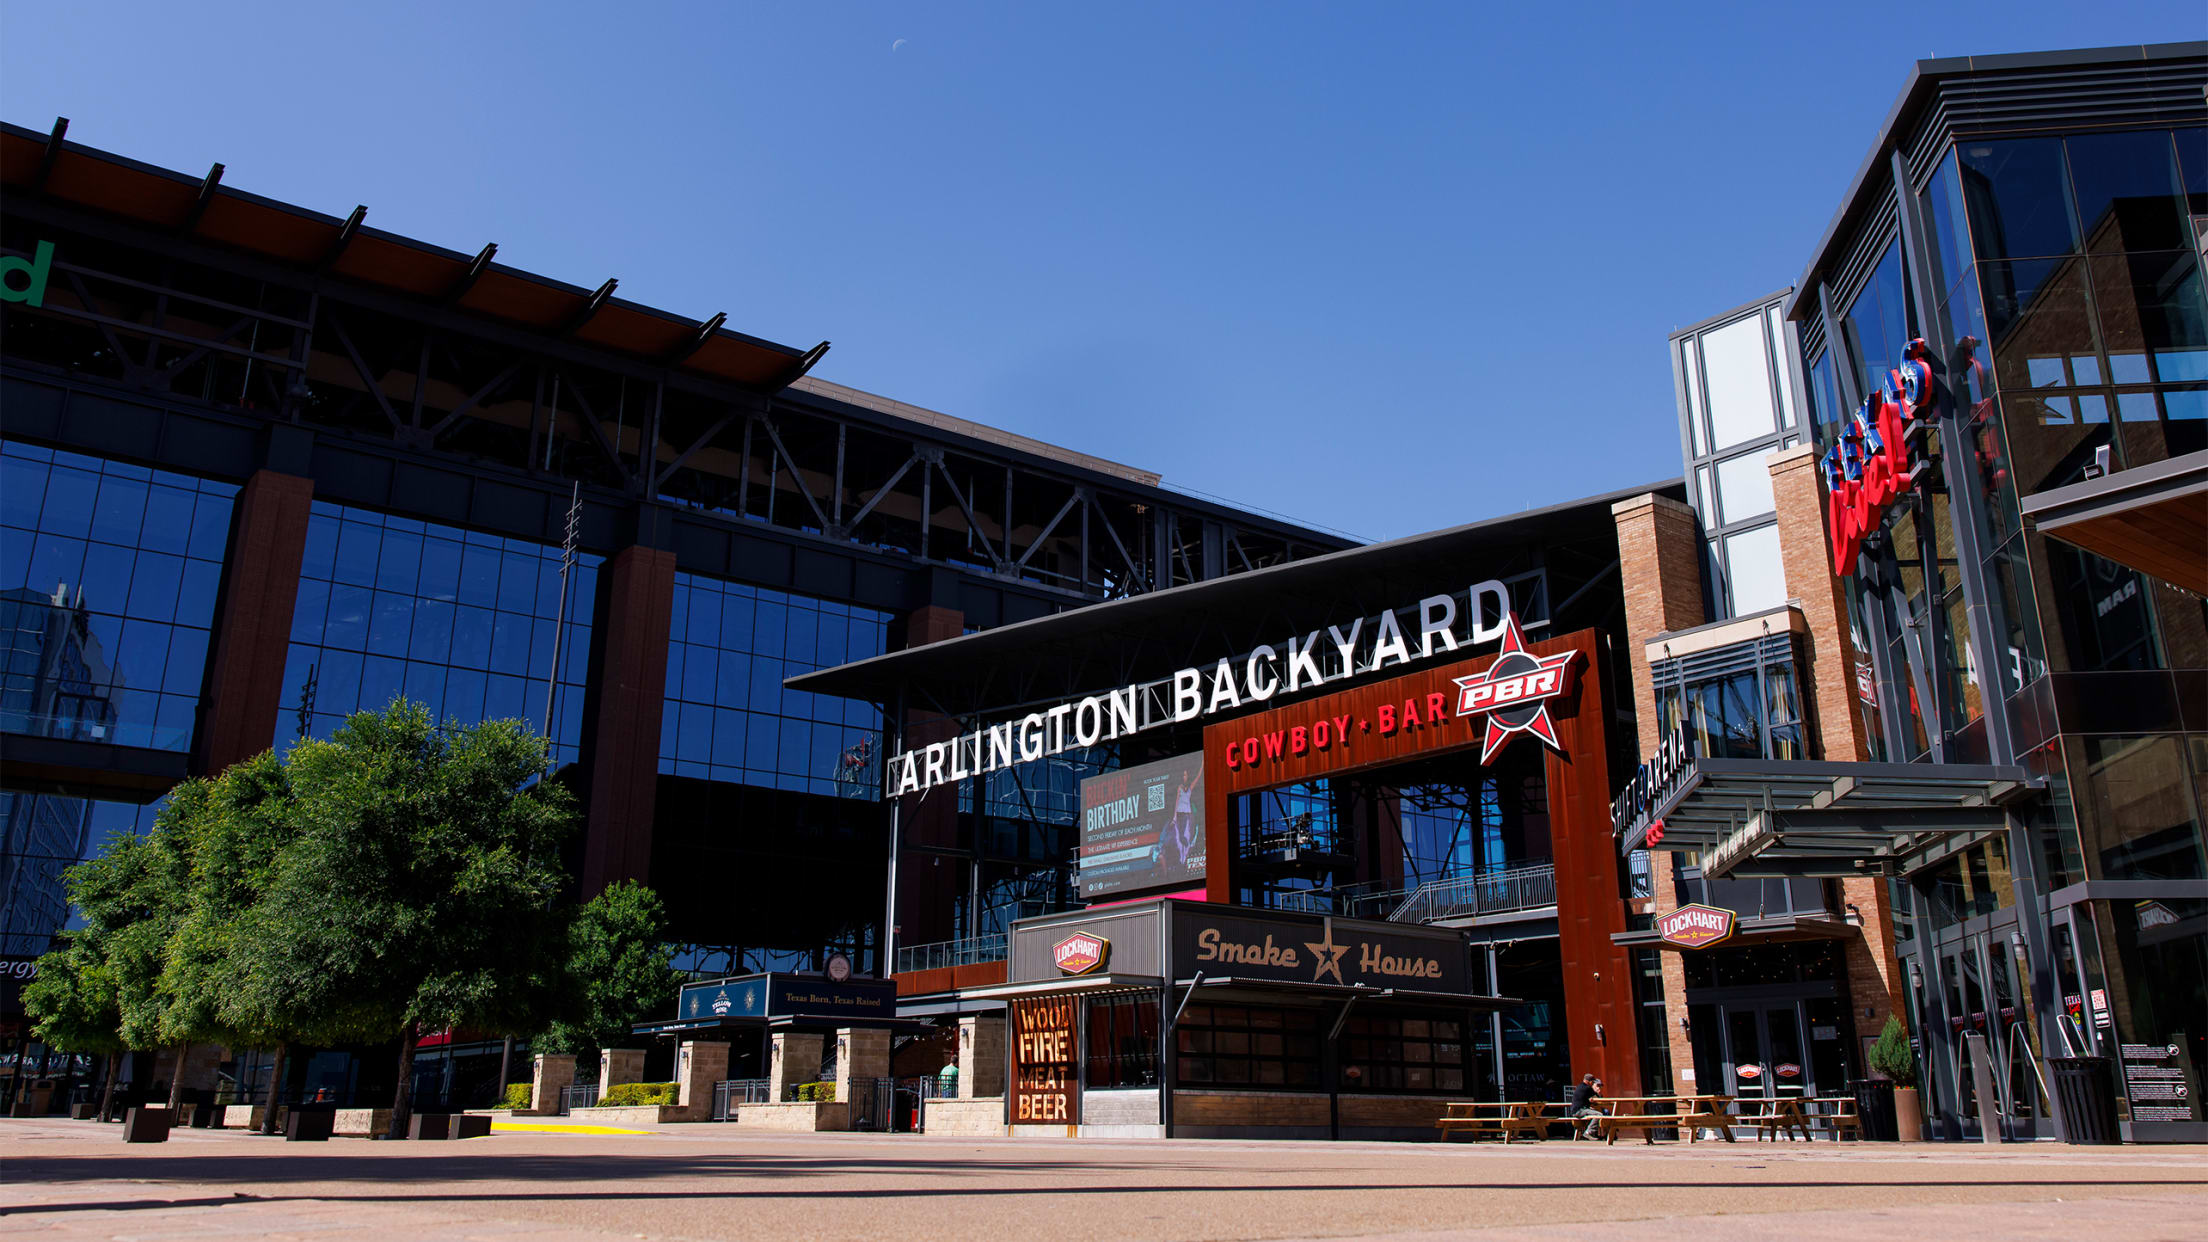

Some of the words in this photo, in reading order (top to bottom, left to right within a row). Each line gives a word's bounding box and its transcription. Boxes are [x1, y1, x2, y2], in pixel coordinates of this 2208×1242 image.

[899, 684, 1137, 795] ARLINGTON
[1174, 579, 1511, 722] BACKYARD
[1463, 670, 1556, 709] PBR
[1226, 714, 1350, 768] COWBOY
[1378, 692, 1448, 734] BAR
[1647, 720, 1686, 800] ARENA
[1087, 794, 1140, 831] BIRTHDAY
[1663, 911, 1724, 936] LOCKHART
[1057, 938, 1098, 963] LOCKHART
[1197, 928, 1300, 968] Smoke
[1360, 943, 1443, 978] House
[786, 993, 808, 1002] Texas
[810, 994, 832, 1004] Born,
[834, 995, 854, 1004] Texas
[856, 996, 881, 1006] Raised
[1021, 1005, 1071, 1030] WOOD
[1020, 1030, 1068, 1064] FIRE
[1020, 1066, 1068, 1090] MEAT
[1019, 1094, 1068, 1120] BEER
